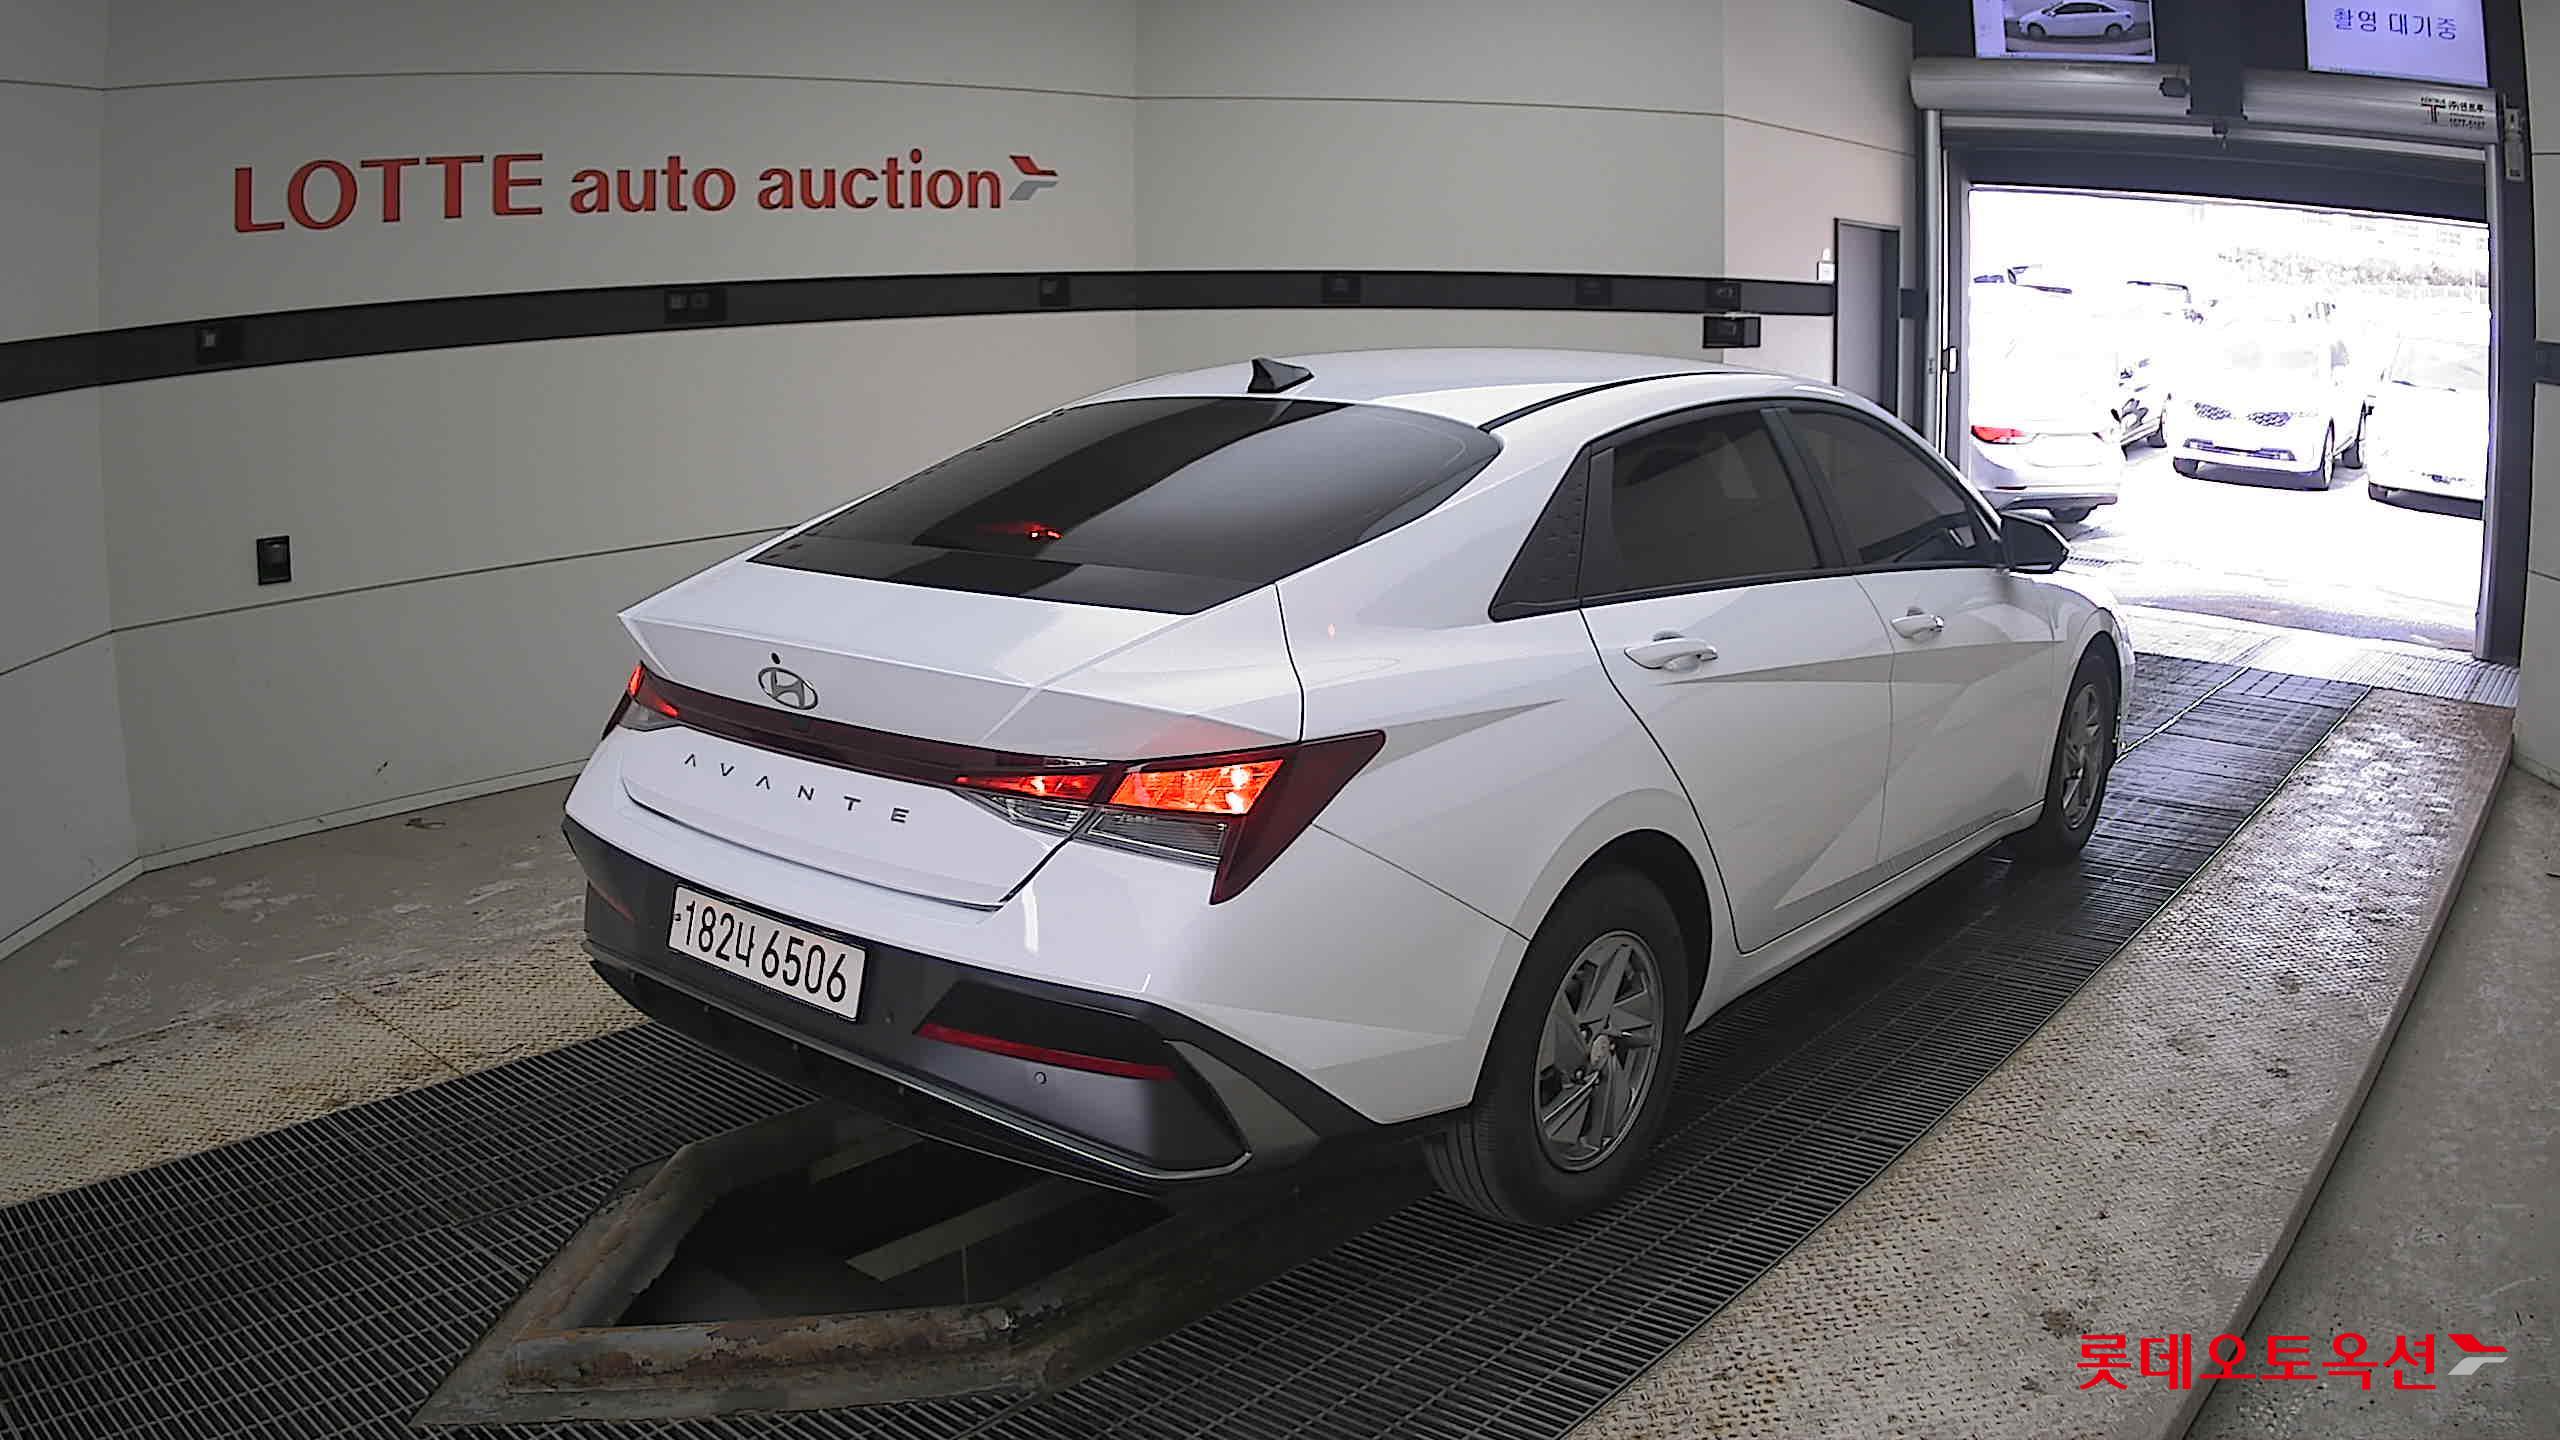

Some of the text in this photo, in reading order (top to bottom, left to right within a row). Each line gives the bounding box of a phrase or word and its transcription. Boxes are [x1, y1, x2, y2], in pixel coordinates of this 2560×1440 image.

[2334, 8, 2456, 40] 촬영 대기중
[234, 148, 1001, 233] LOTTE auto auction
[684, 753, 909, 823] AVANTE
[761, 930, 847, 1003] 6506
